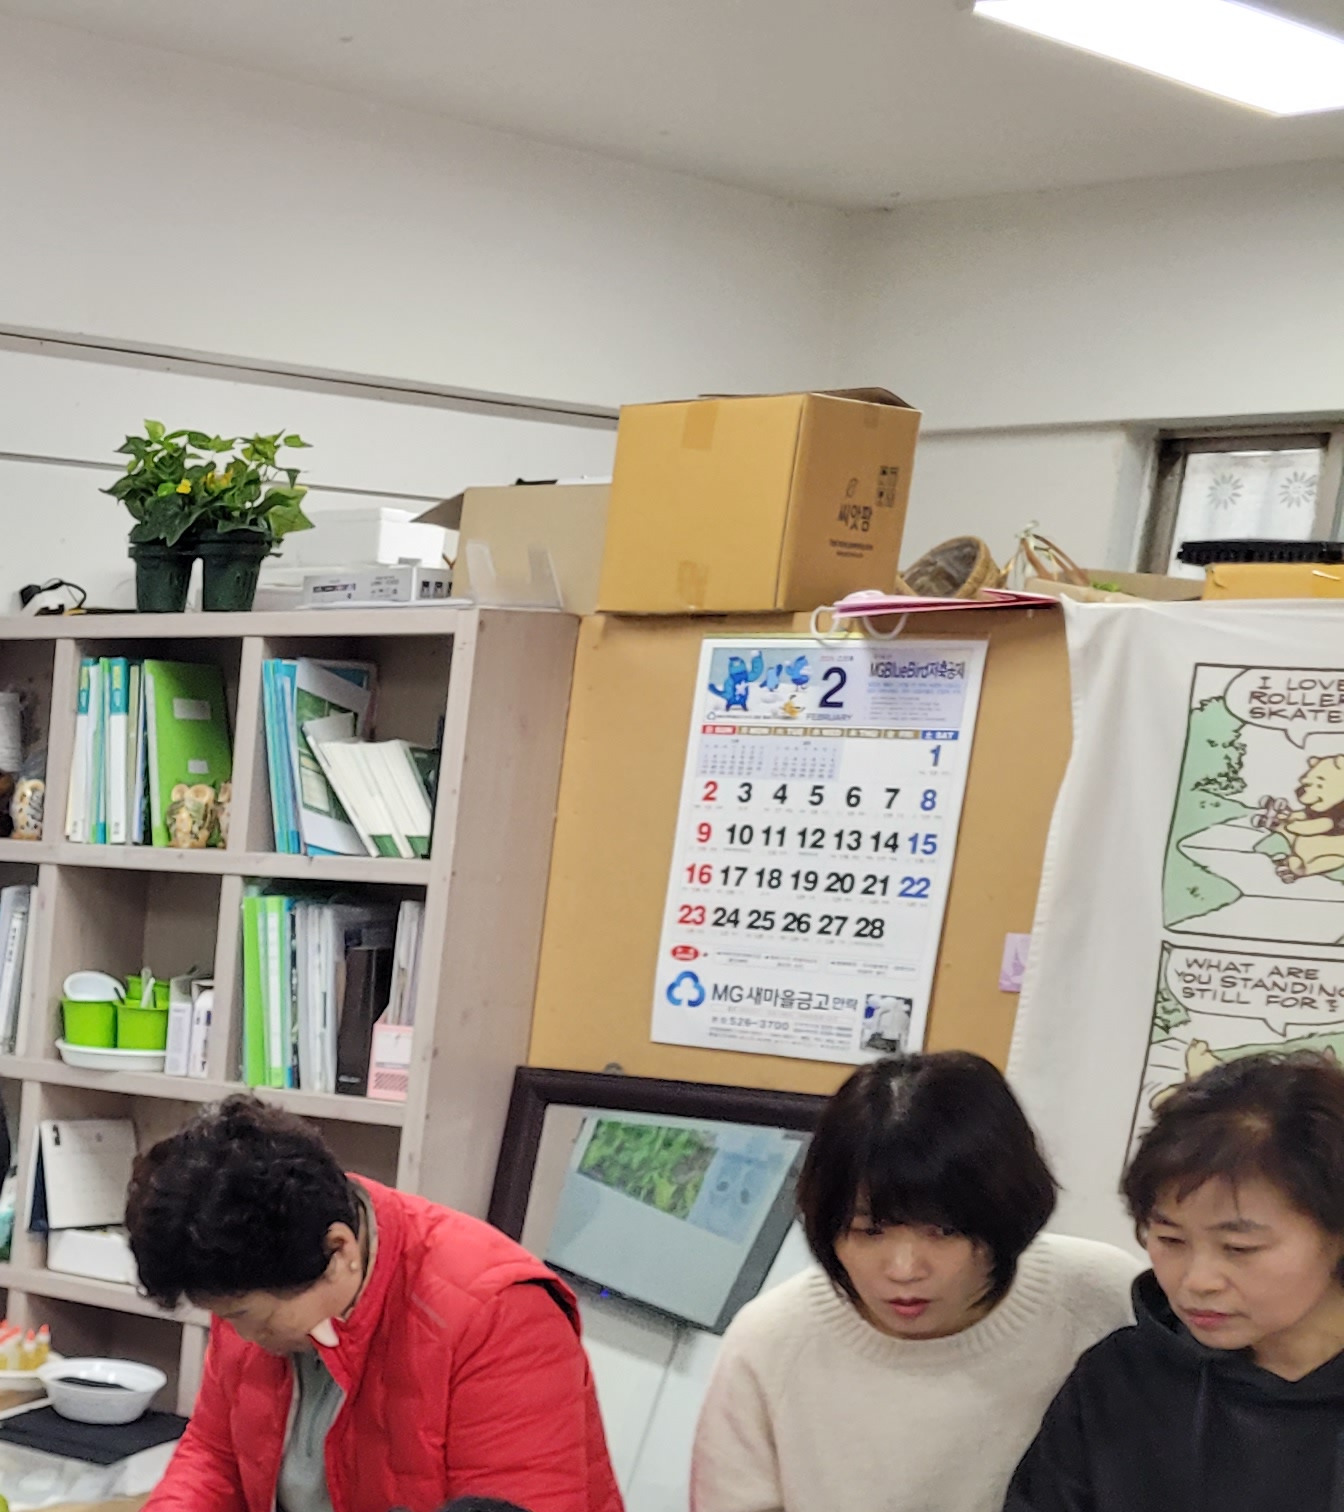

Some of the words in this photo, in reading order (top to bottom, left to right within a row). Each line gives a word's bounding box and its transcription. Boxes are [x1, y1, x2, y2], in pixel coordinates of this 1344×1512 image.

[818, 666, 847, 708] 2
[1257, 676, 1272, 689] I
[1249, 706, 1344, 724] SKATE
[929, 744, 942, 767] 1
[701, 780, 719, 802] 2
[737, 782, 753, 803] 3
[773, 783, 788, 804] 4
[808, 785, 825, 806] 5
[846, 786, 862, 808] 6
[884, 788, 901, 809] 7
[920, 789, 938, 811] 8
[696, 822, 712, 843] 9
[726, 824, 754, 845] 10
[761, 826, 787, 847] 11
[797, 828, 826, 849] 12
[833, 829, 862, 851] 13
[870, 831, 900, 853] 14
[907, 833, 938, 855] 15
[684, 863, 713, 885] 16
[720, 865, 748, 887] 17
[755, 868, 783, 889] 18
[790, 870, 819, 892] 19
[824, 872, 855, 894] 20
[860, 874, 890, 897] 21
[897, 876, 932, 899] 22
[677, 904, 706, 926] 23
[711, 906, 740, 928] 24
[746, 909, 776, 931] 25
[781, 912, 812, 934] 26
[817, 914, 849, 937] 27
[853, 917, 885, 939] 28
[1174, 968, 1212, 984] YOU
[1185, 957, 1255, 974] WHAT
[1267, 965, 1320, 980] ARE
[1182, 986, 1252, 1005] STILL
